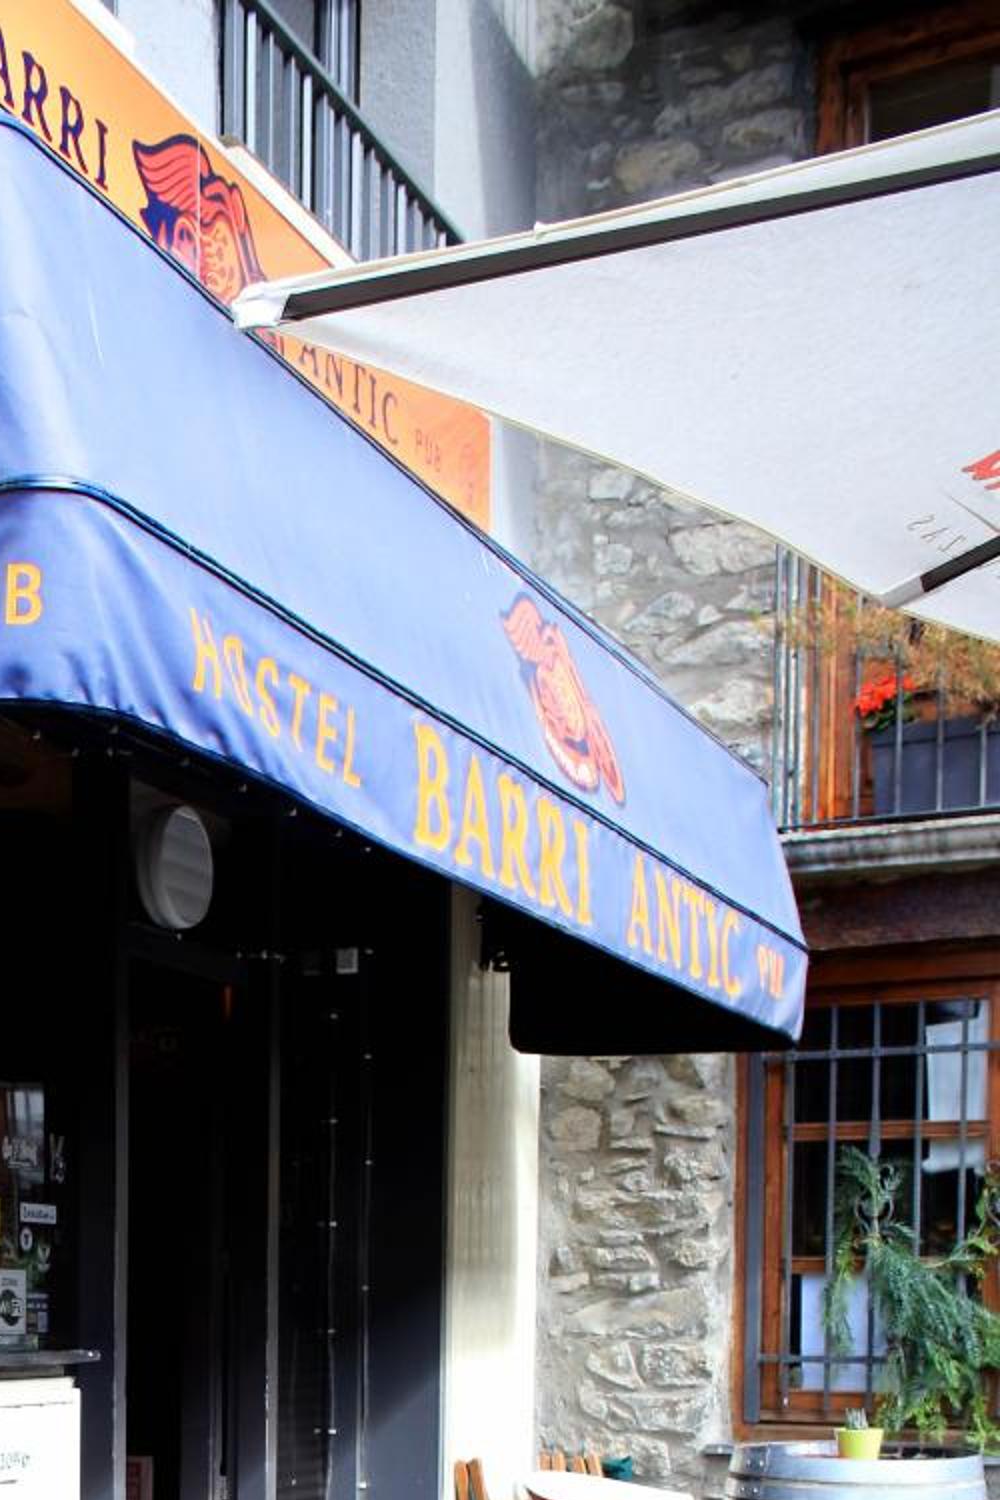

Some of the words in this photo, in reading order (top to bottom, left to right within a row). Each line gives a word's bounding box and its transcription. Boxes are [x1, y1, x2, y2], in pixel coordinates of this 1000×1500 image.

[299, 344, 399, 446] ANTIC
[189, 607, 362, 789] HOSTEL
[413, 719, 592, 926] BARRI
[627, 853, 743, 997] ANTIC
